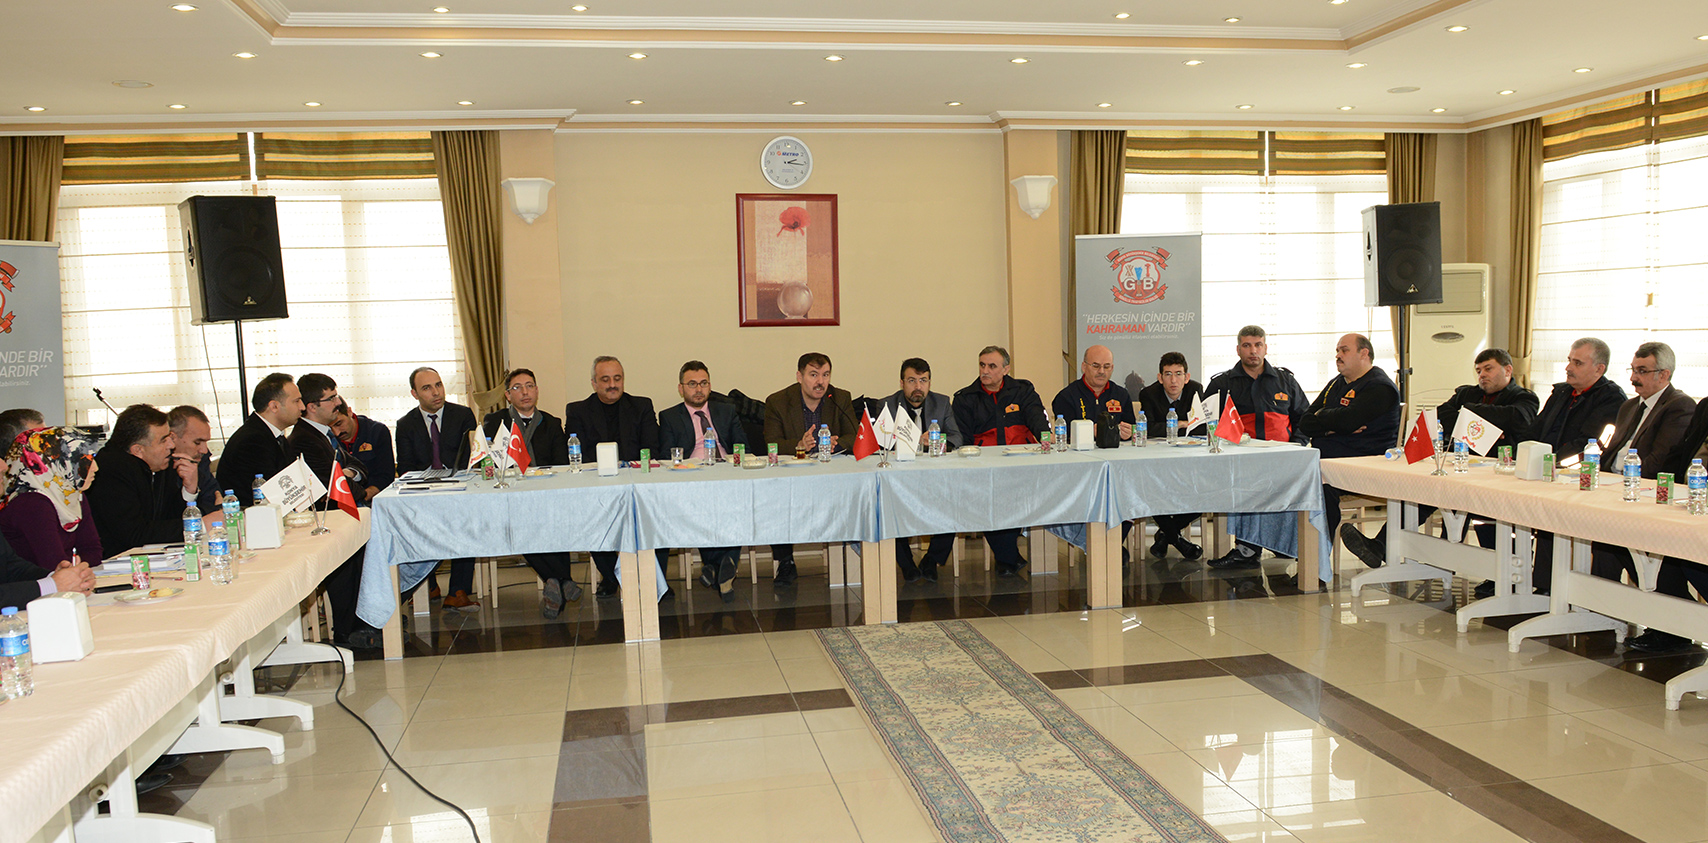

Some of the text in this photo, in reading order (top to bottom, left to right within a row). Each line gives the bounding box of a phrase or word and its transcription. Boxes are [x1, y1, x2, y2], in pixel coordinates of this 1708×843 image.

[1124, 278, 1154, 290] G B
[1140, 311, 1176, 324] İÇİNDE
[1177, 310, 1195, 321] BİR
[1086, 324, 1146, 334] KAHRAMAN
[28, 348, 54, 362] BİR
